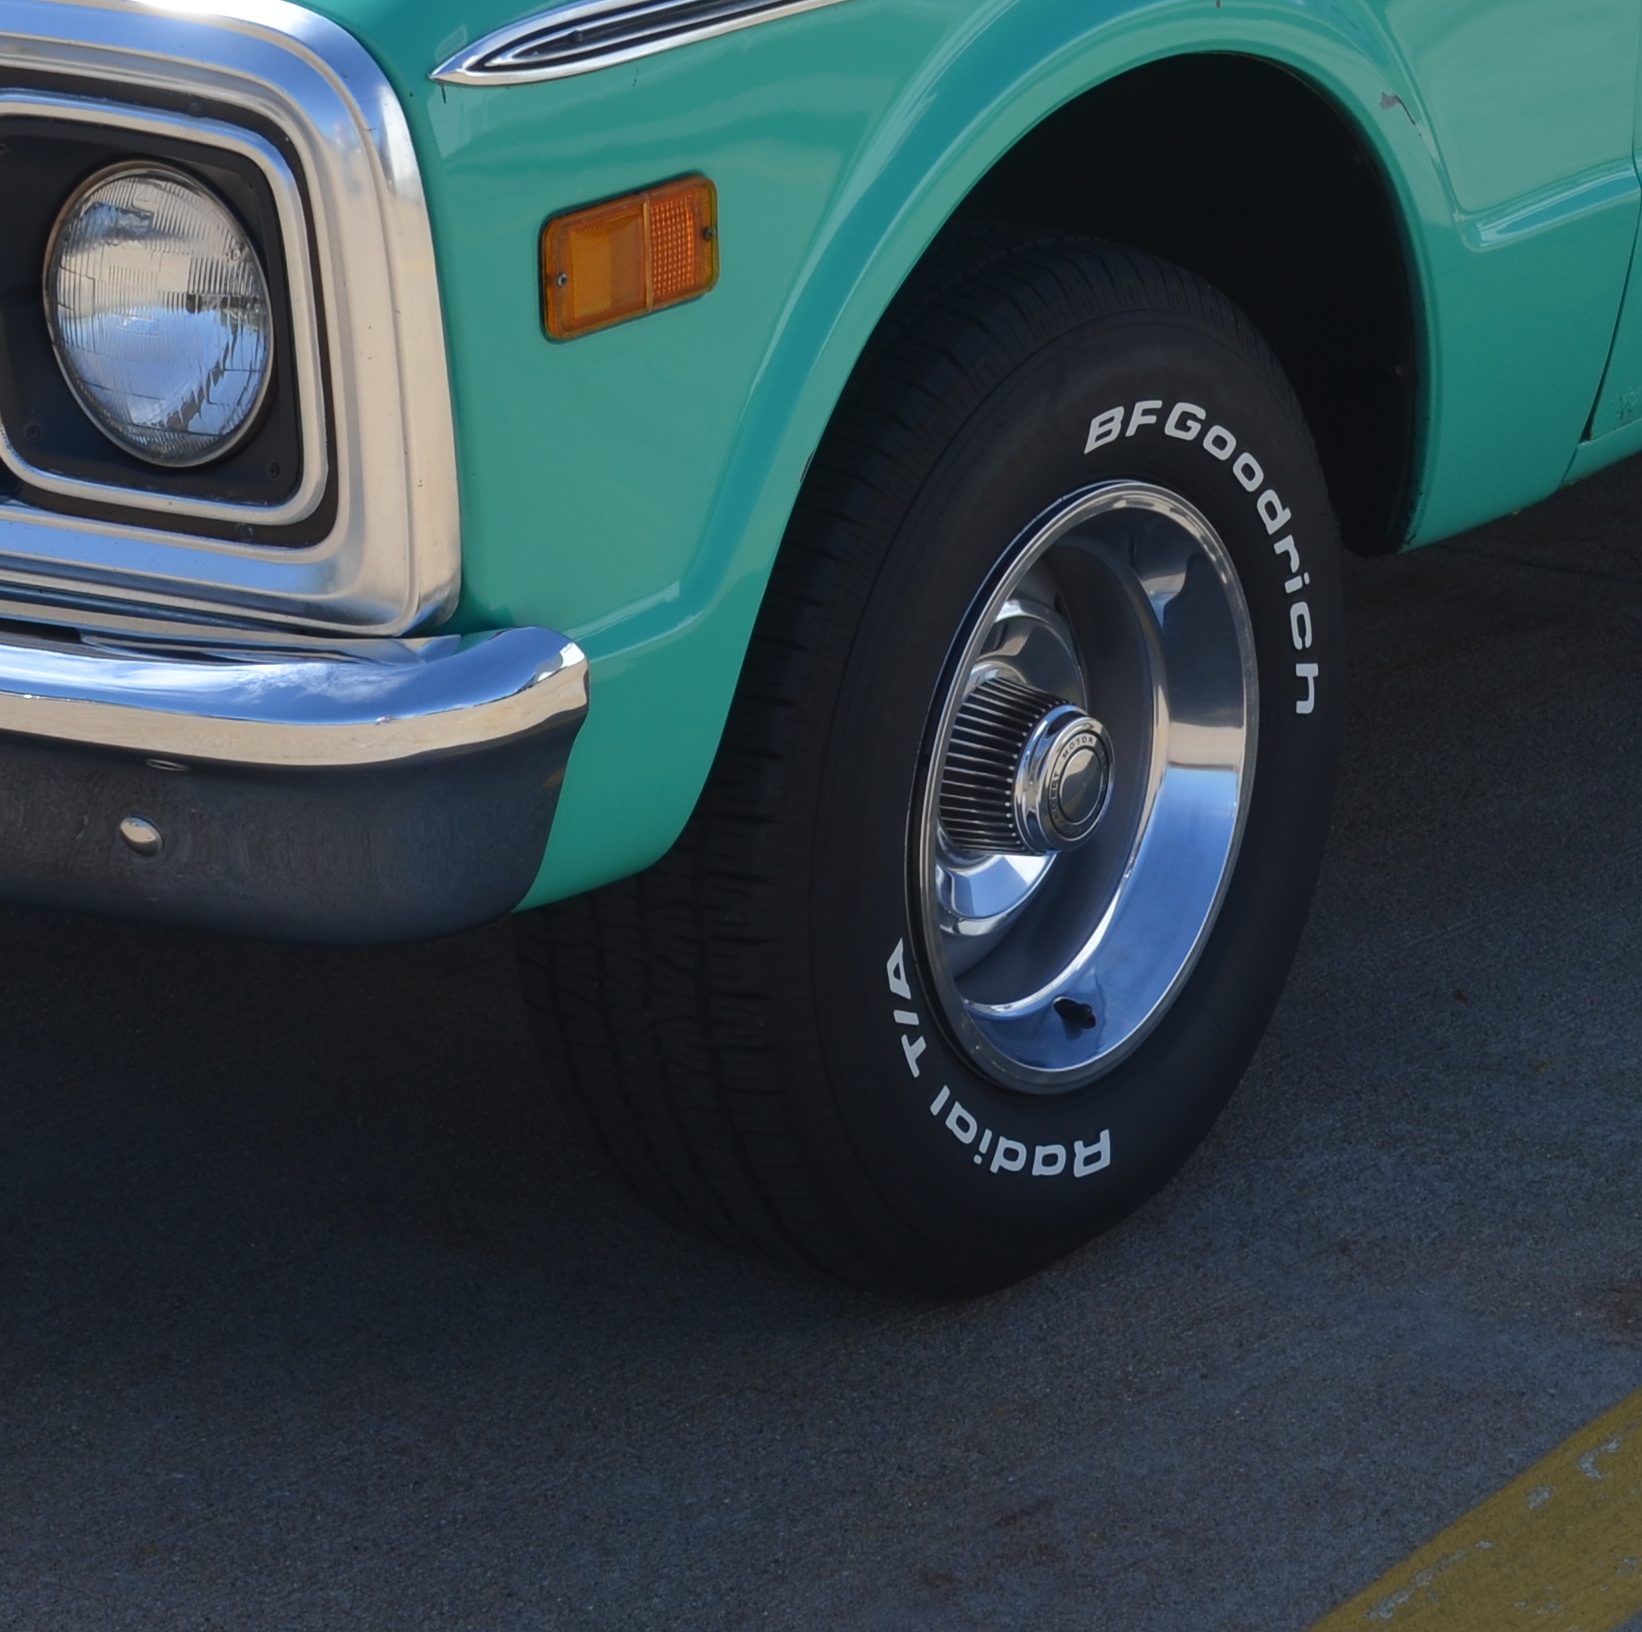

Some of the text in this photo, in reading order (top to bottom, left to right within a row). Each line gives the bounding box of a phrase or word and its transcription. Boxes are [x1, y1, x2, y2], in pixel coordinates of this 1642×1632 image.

[1083, 399, 1319, 714] BFGoodrich
[1062, 736, 1094, 760] MOTOR
[886, 937, 1111, 1178] Radial T/A
